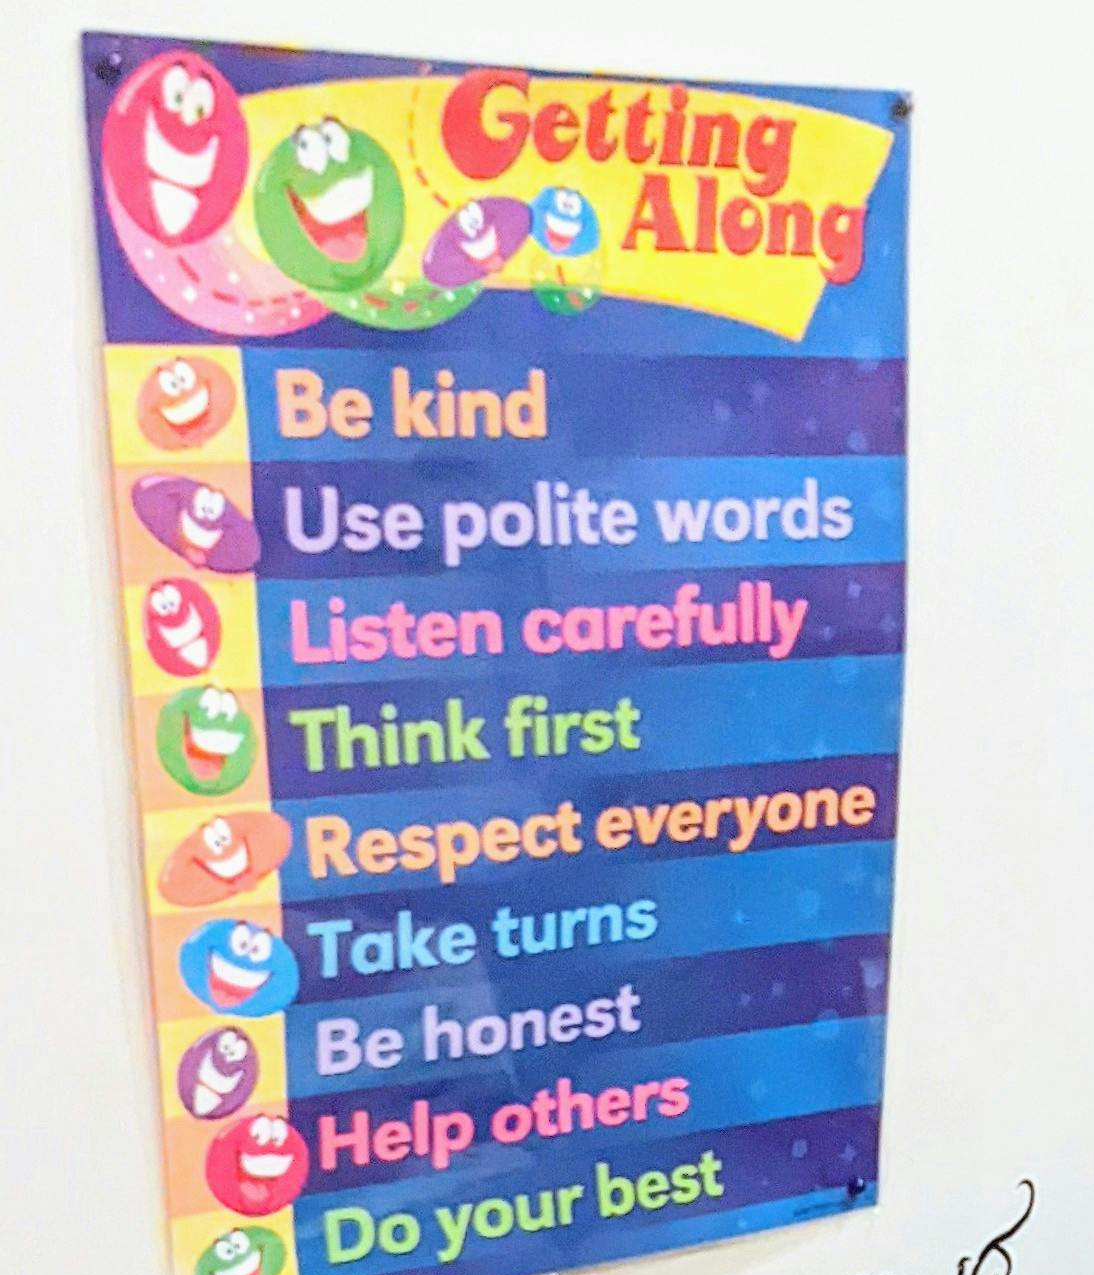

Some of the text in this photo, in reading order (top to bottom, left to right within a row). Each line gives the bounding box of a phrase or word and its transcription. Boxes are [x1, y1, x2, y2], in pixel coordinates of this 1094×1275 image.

[442, 67, 796, 196] Getting
[622, 176, 866, 285] Along
[274, 369, 547, 440] Be kind
[285, 478, 854, 565] Use polite words
[291, 582, 807, 664] Listen carefully
[290, 697, 641, 773] Think first
[307, 782, 877, 885] Respect everyone
[308, 898, 660, 980] Take turns
[316, 985, 642, 1077] Be honest
[320, 1076, 691, 1173] Help others
[325, 1152, 725, 1267] Do your best
